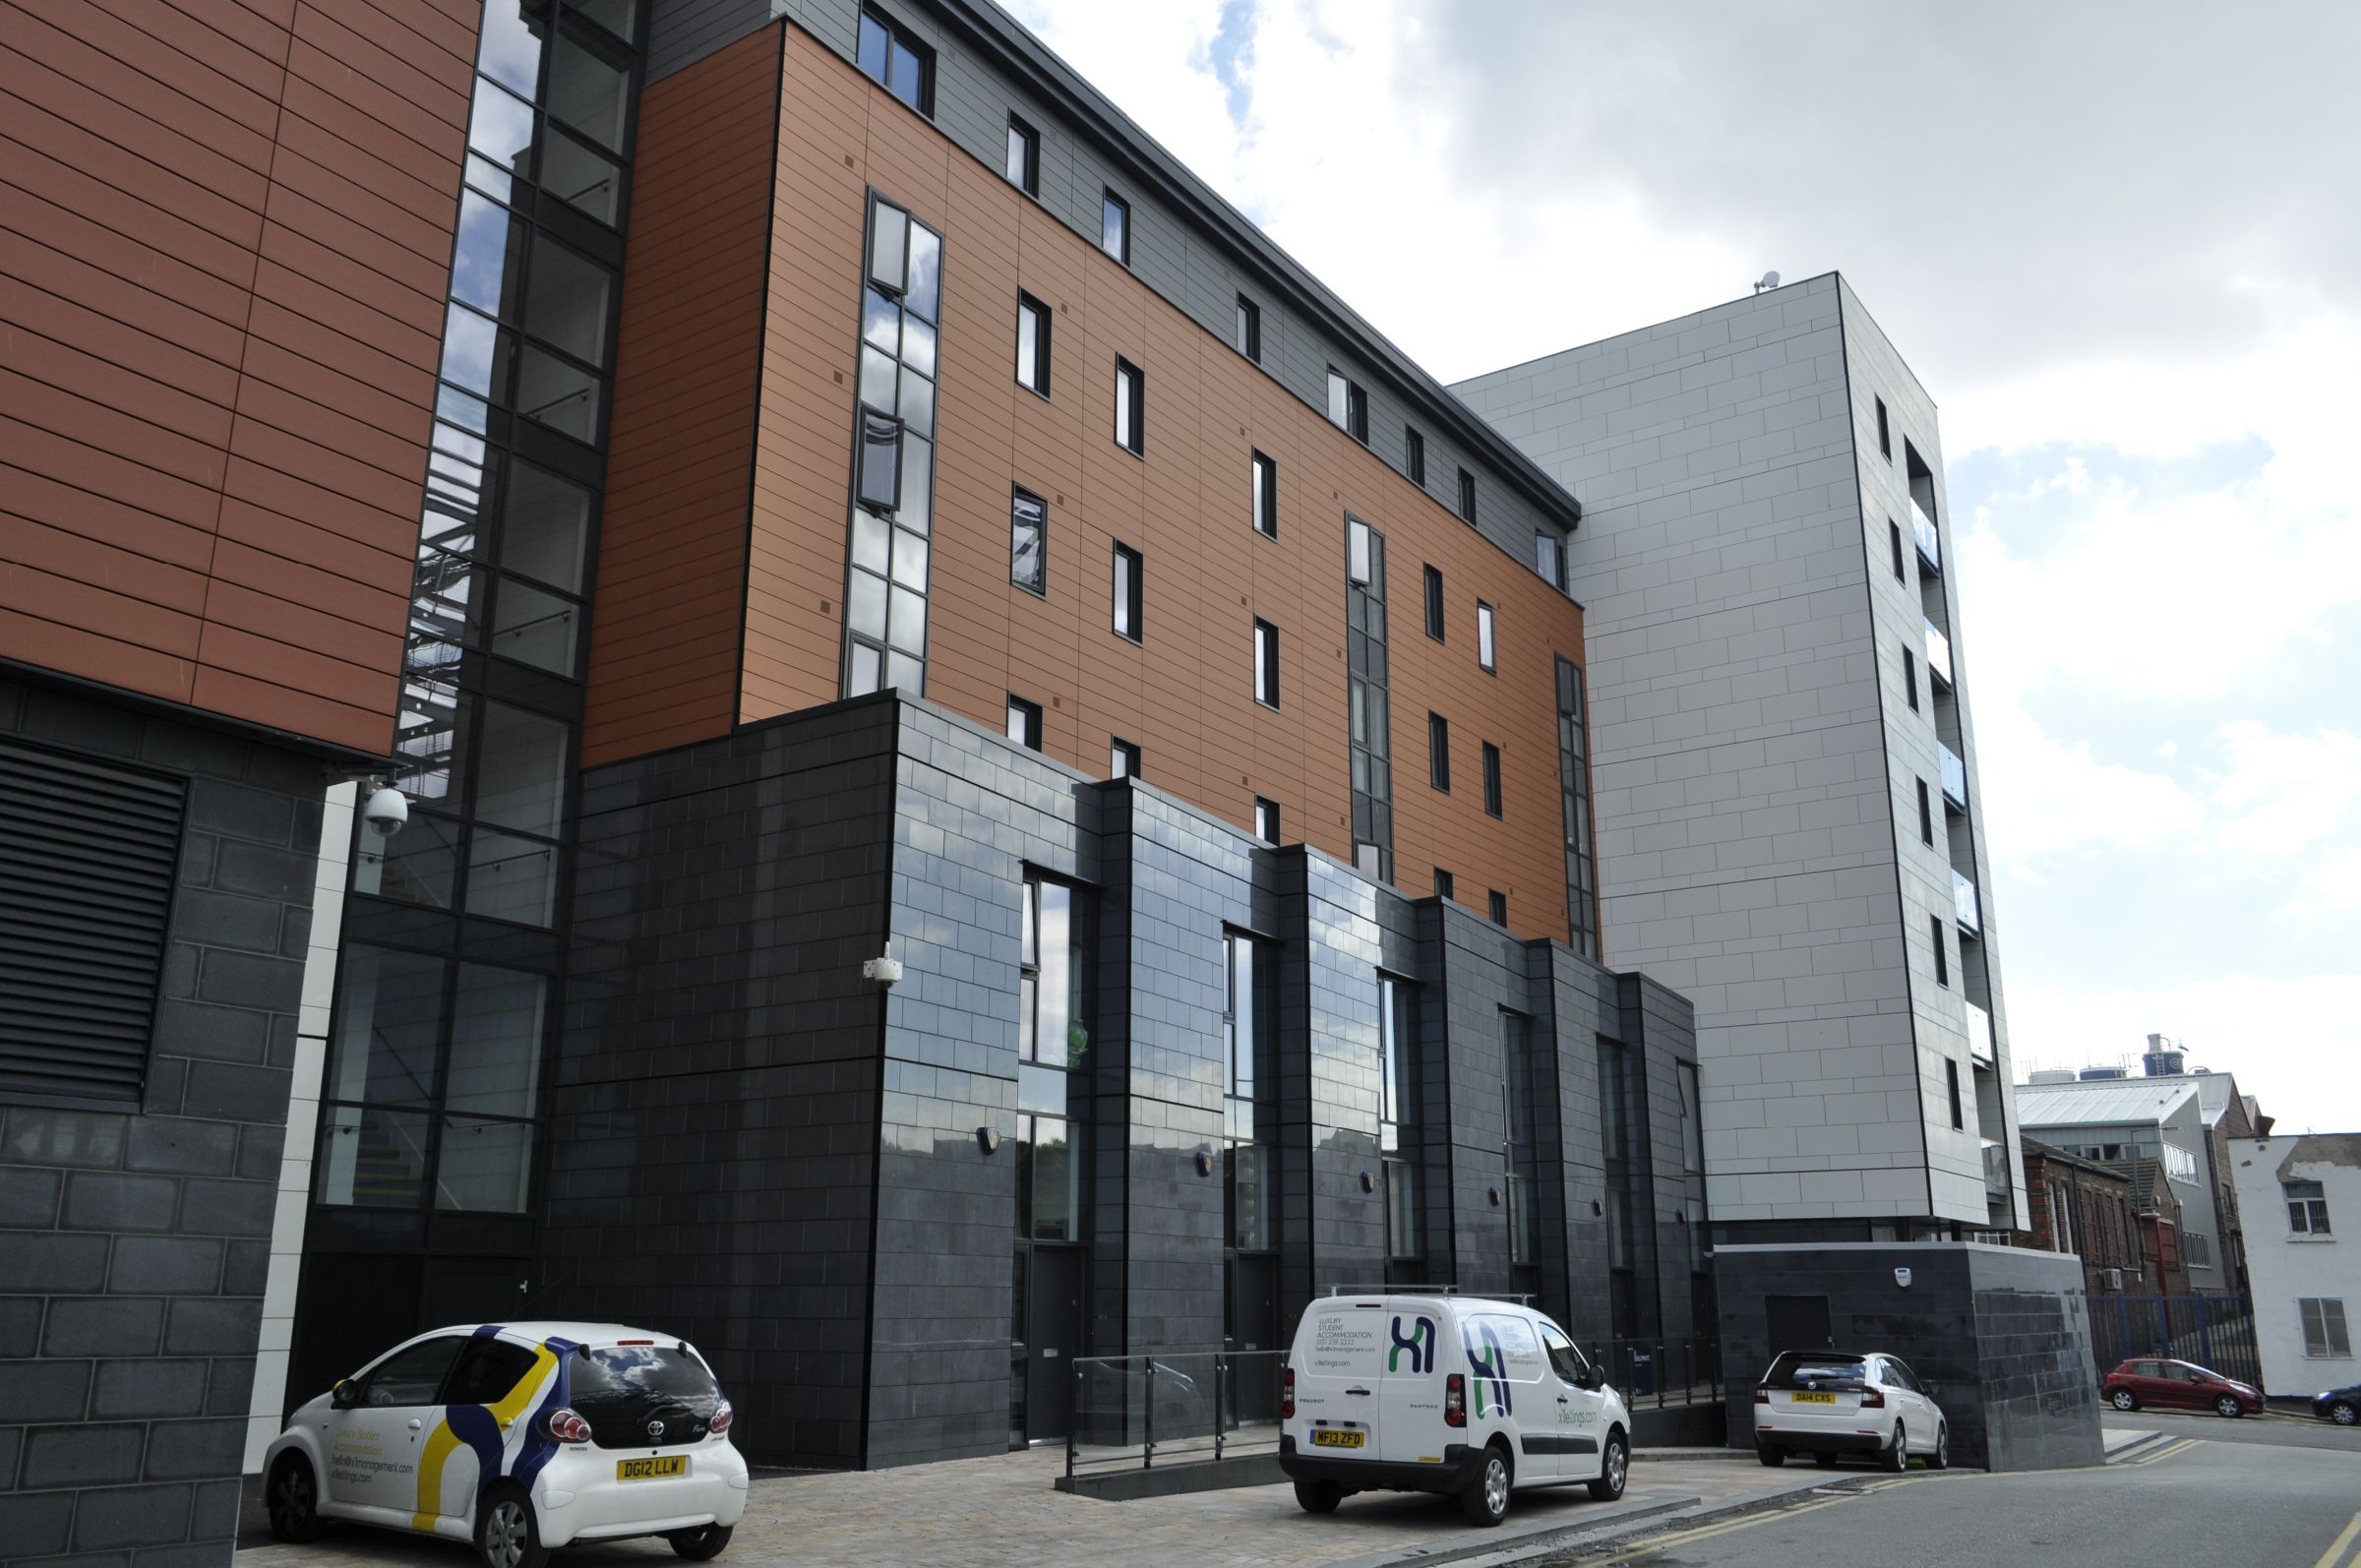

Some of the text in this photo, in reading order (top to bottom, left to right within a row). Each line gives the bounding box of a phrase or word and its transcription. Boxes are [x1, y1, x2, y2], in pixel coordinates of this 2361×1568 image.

[1317, 1431, 1361, 1445] MF13 ZFD
[624, 1458, 680, 1478] DG12 LLW
